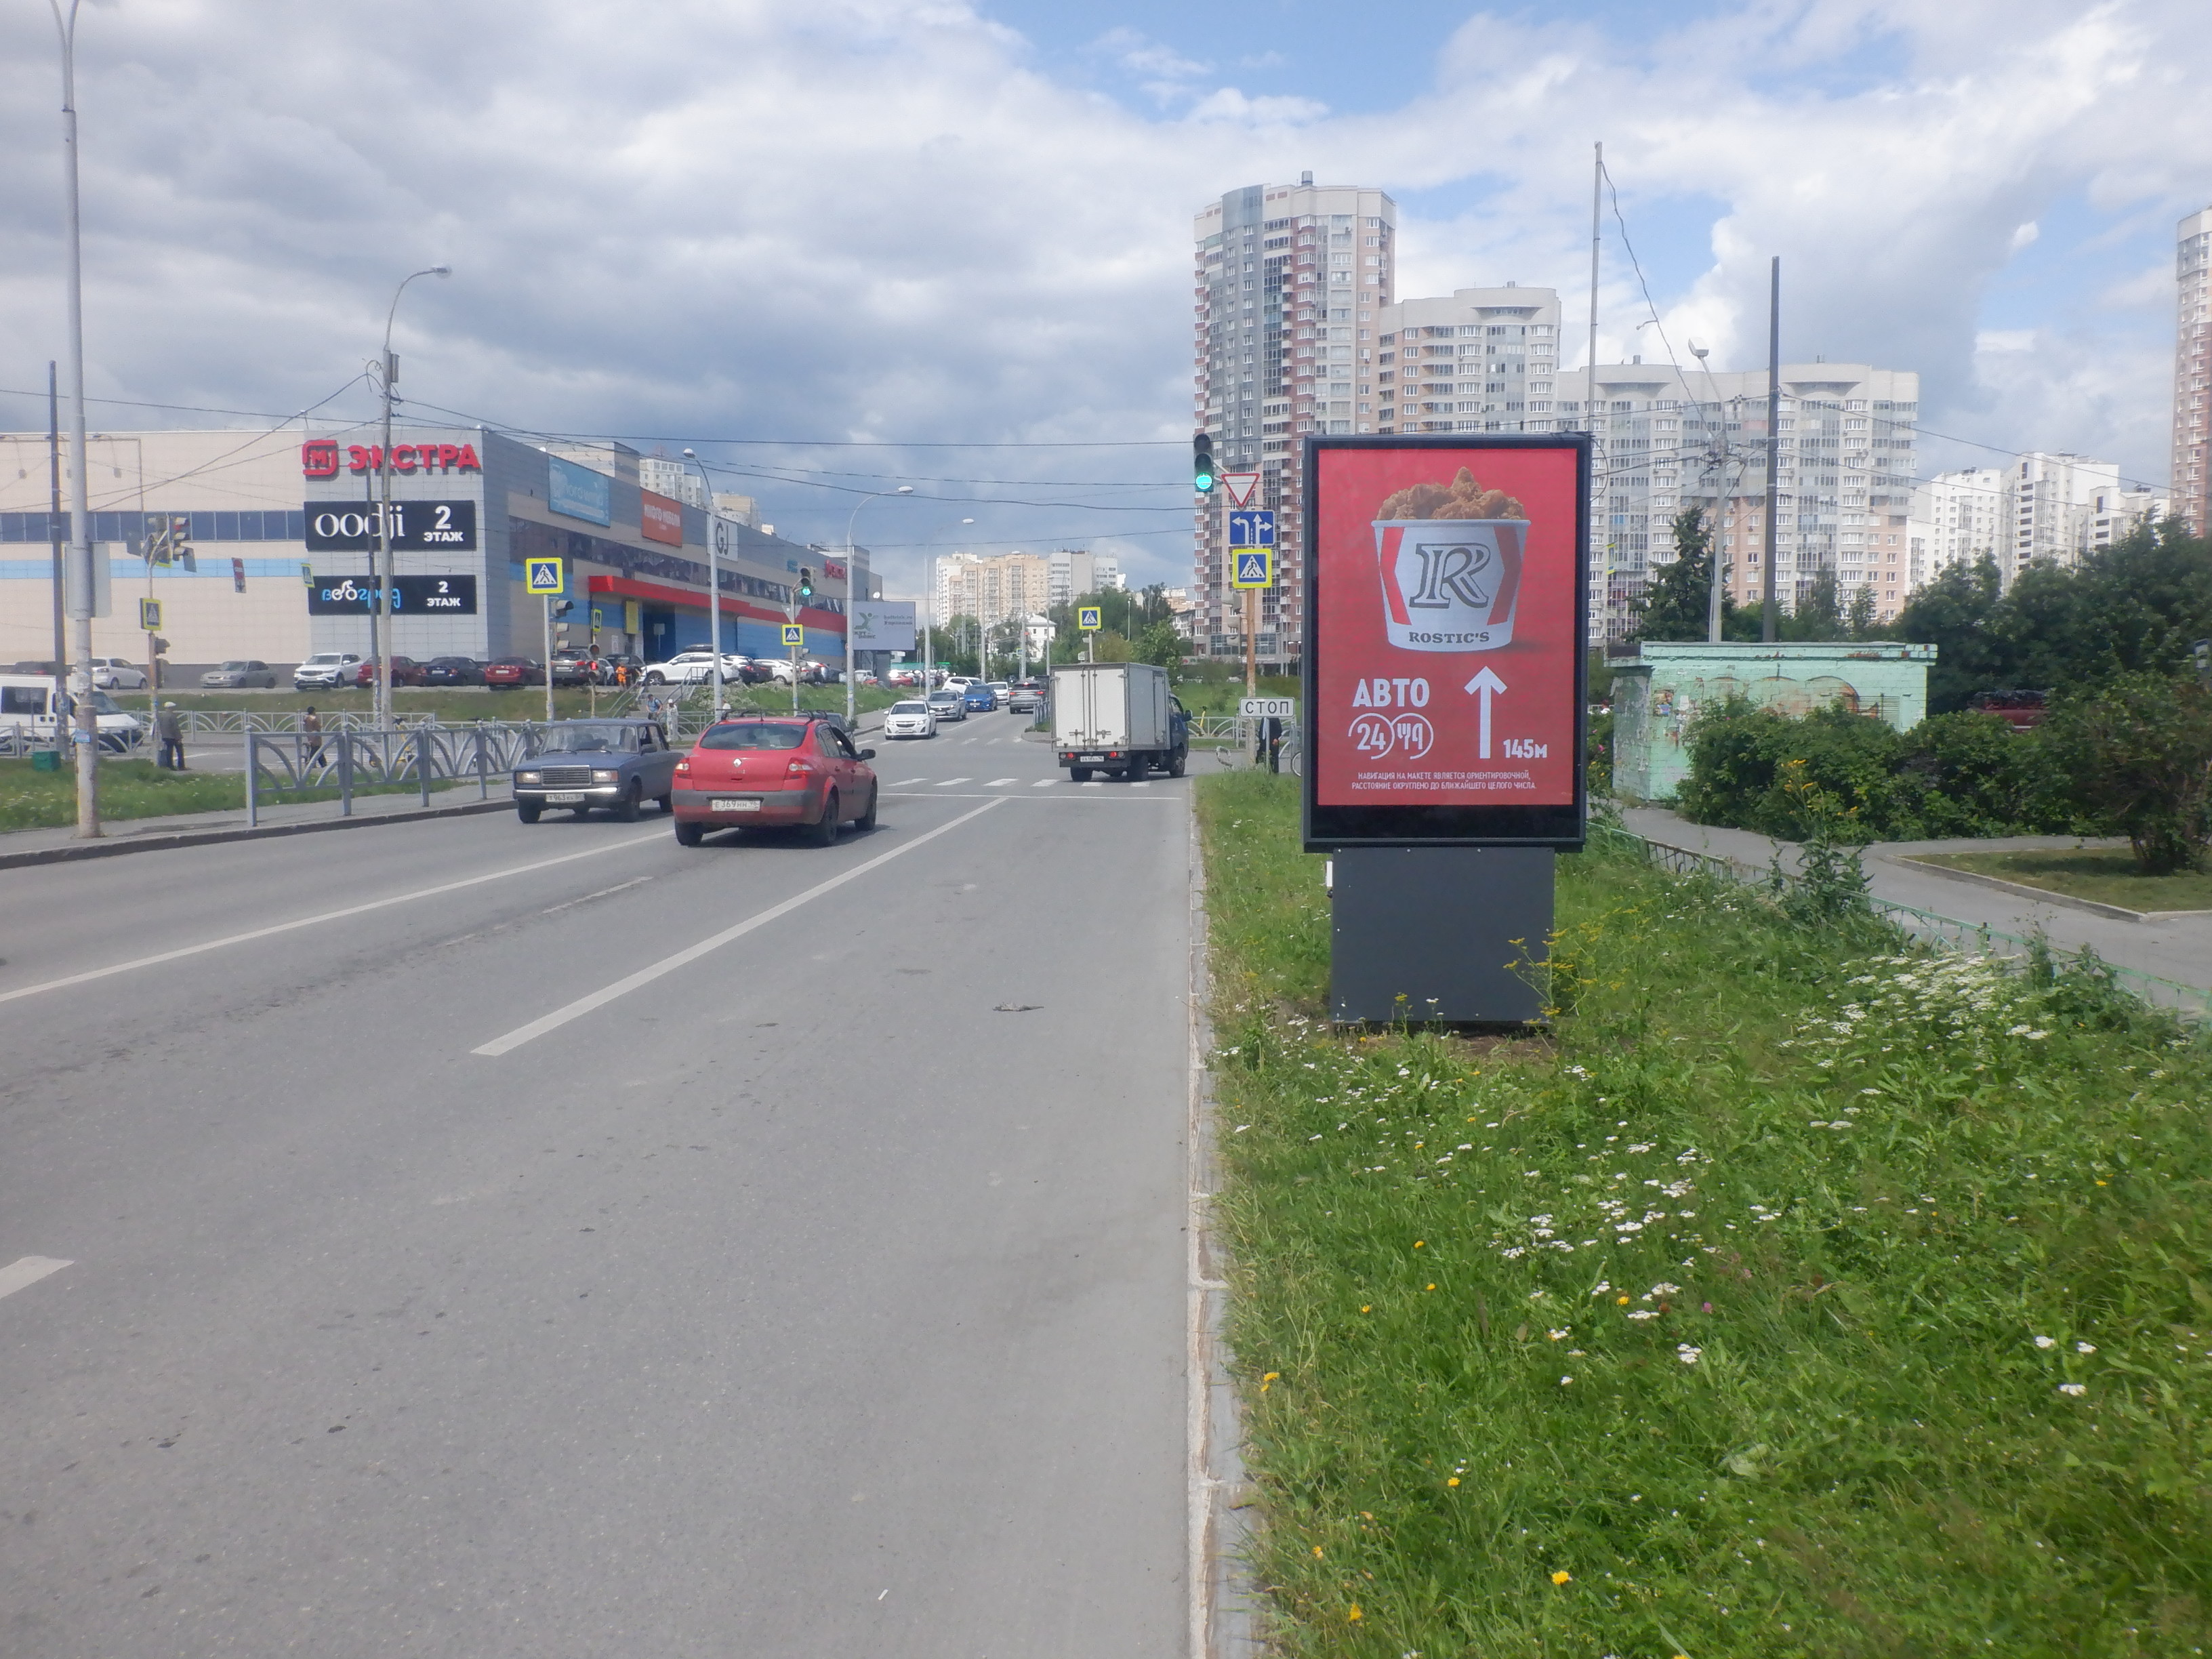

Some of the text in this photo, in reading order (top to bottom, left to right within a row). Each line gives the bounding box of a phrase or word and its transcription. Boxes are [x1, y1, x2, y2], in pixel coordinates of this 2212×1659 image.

[348, 445, 482, 470] ЭКСТРА
[314, 503, 406, 539] oodji
[434, 505, 452, 529] 2
[424, 531, 464, 542] ЭТАЖ
[716, 521, 729, 556] GJ
[438, 581, 449, 593] 2
[1409, 542, 1491, 609] R
[426, 597, 462, 607] ЭТАЖ
[1409, 632, 1490, 644] ROSTIC'S
[1353, 678, 1430, 708] АВТО
[1246, 701, 1289, 714] СТОП
[1357, 722, 1387, 750] 24
[1431, 782, 1439, 790] ДО
[1441, 780, 1486, 790] БЛИЖАЙШЕГО
[1488, 782, 1512, 790] ЦЕЛОГО
